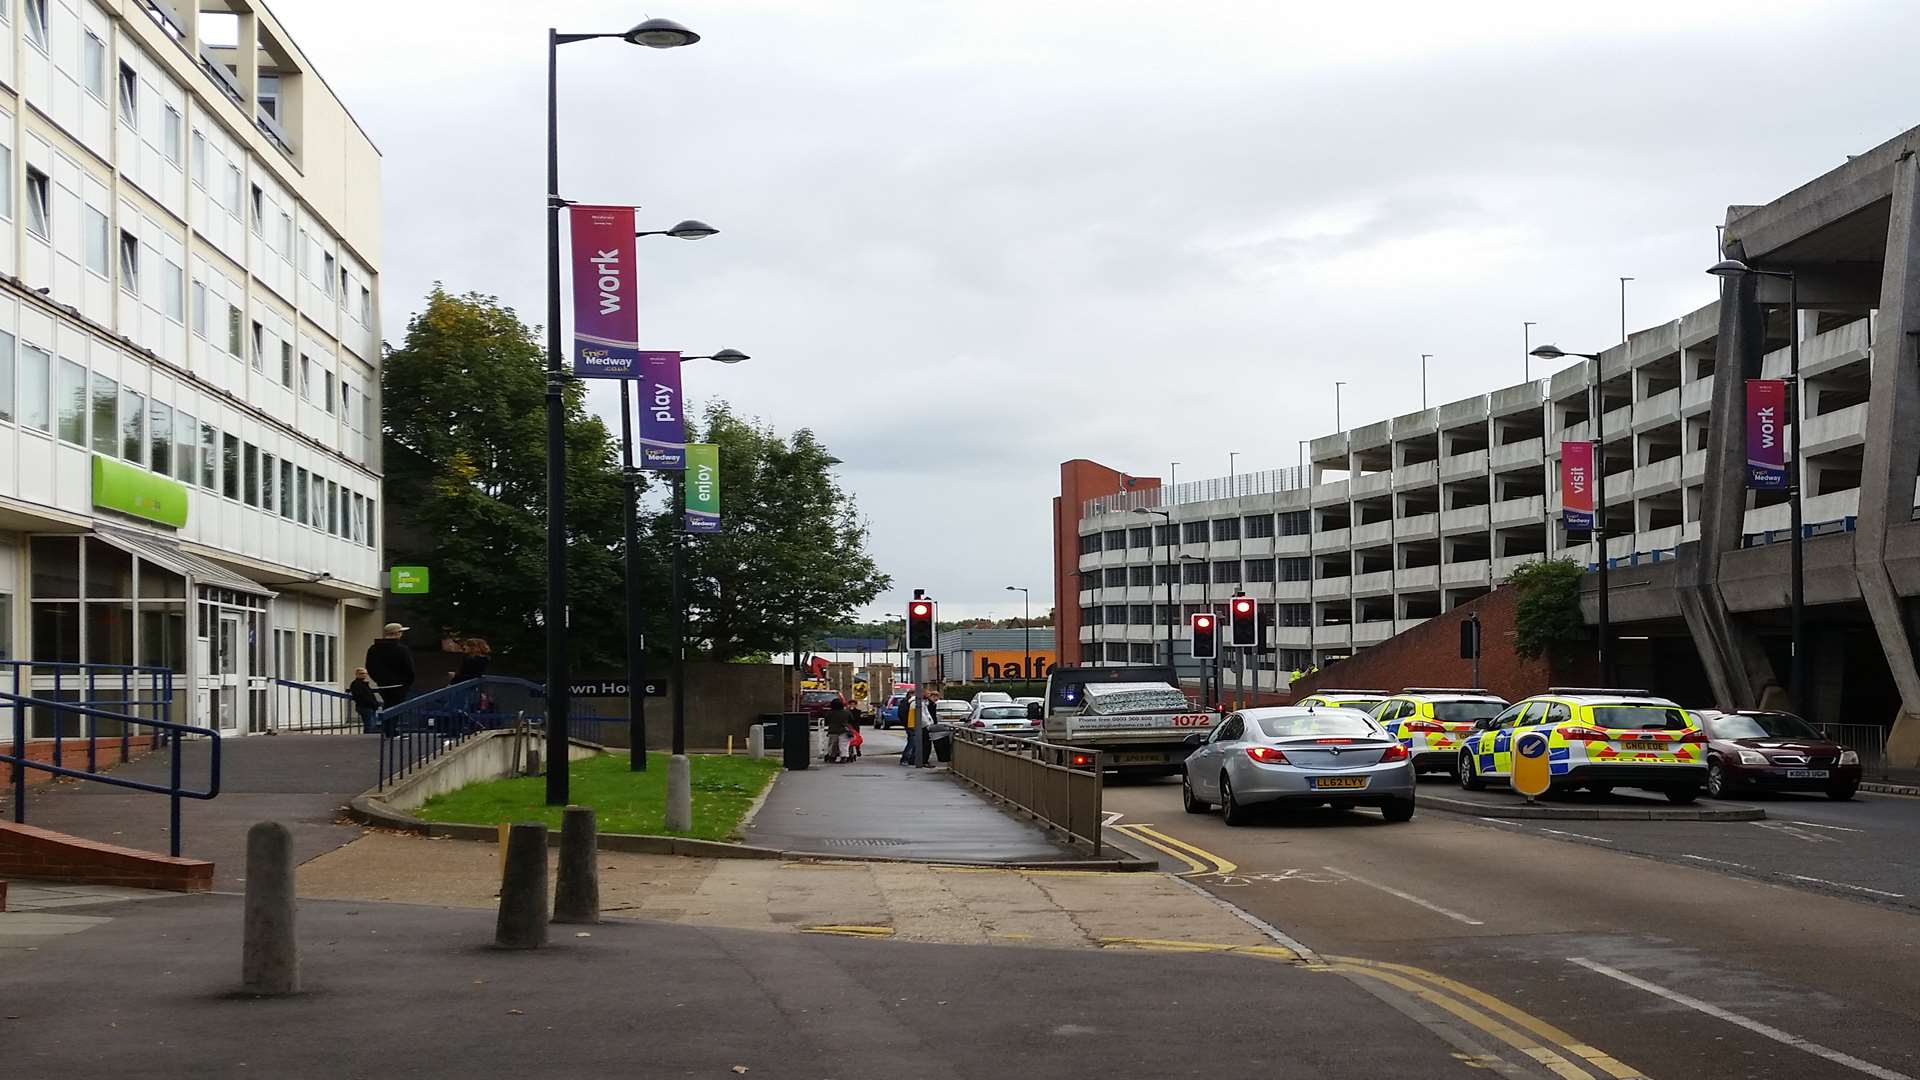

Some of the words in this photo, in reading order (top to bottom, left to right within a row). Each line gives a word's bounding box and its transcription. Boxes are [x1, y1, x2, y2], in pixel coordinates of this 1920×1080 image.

[590, 249, 620, 315] work
[586, 357, 632, 367] Medway
[651, 384, 675, 422] play
[1757, 407, 1774, 449] work
[648, 454, 680, 462] Medway
[695, 464, 712, 502] enjoy
[1570, 467, 1584, 494] visit
[1755, 473, 1781, 482] Medway
[1172, 715, 1210, 727] 1072
[1317, 778, 1342, 787] LL62
[1344, 778, 1364, 787] LYY
